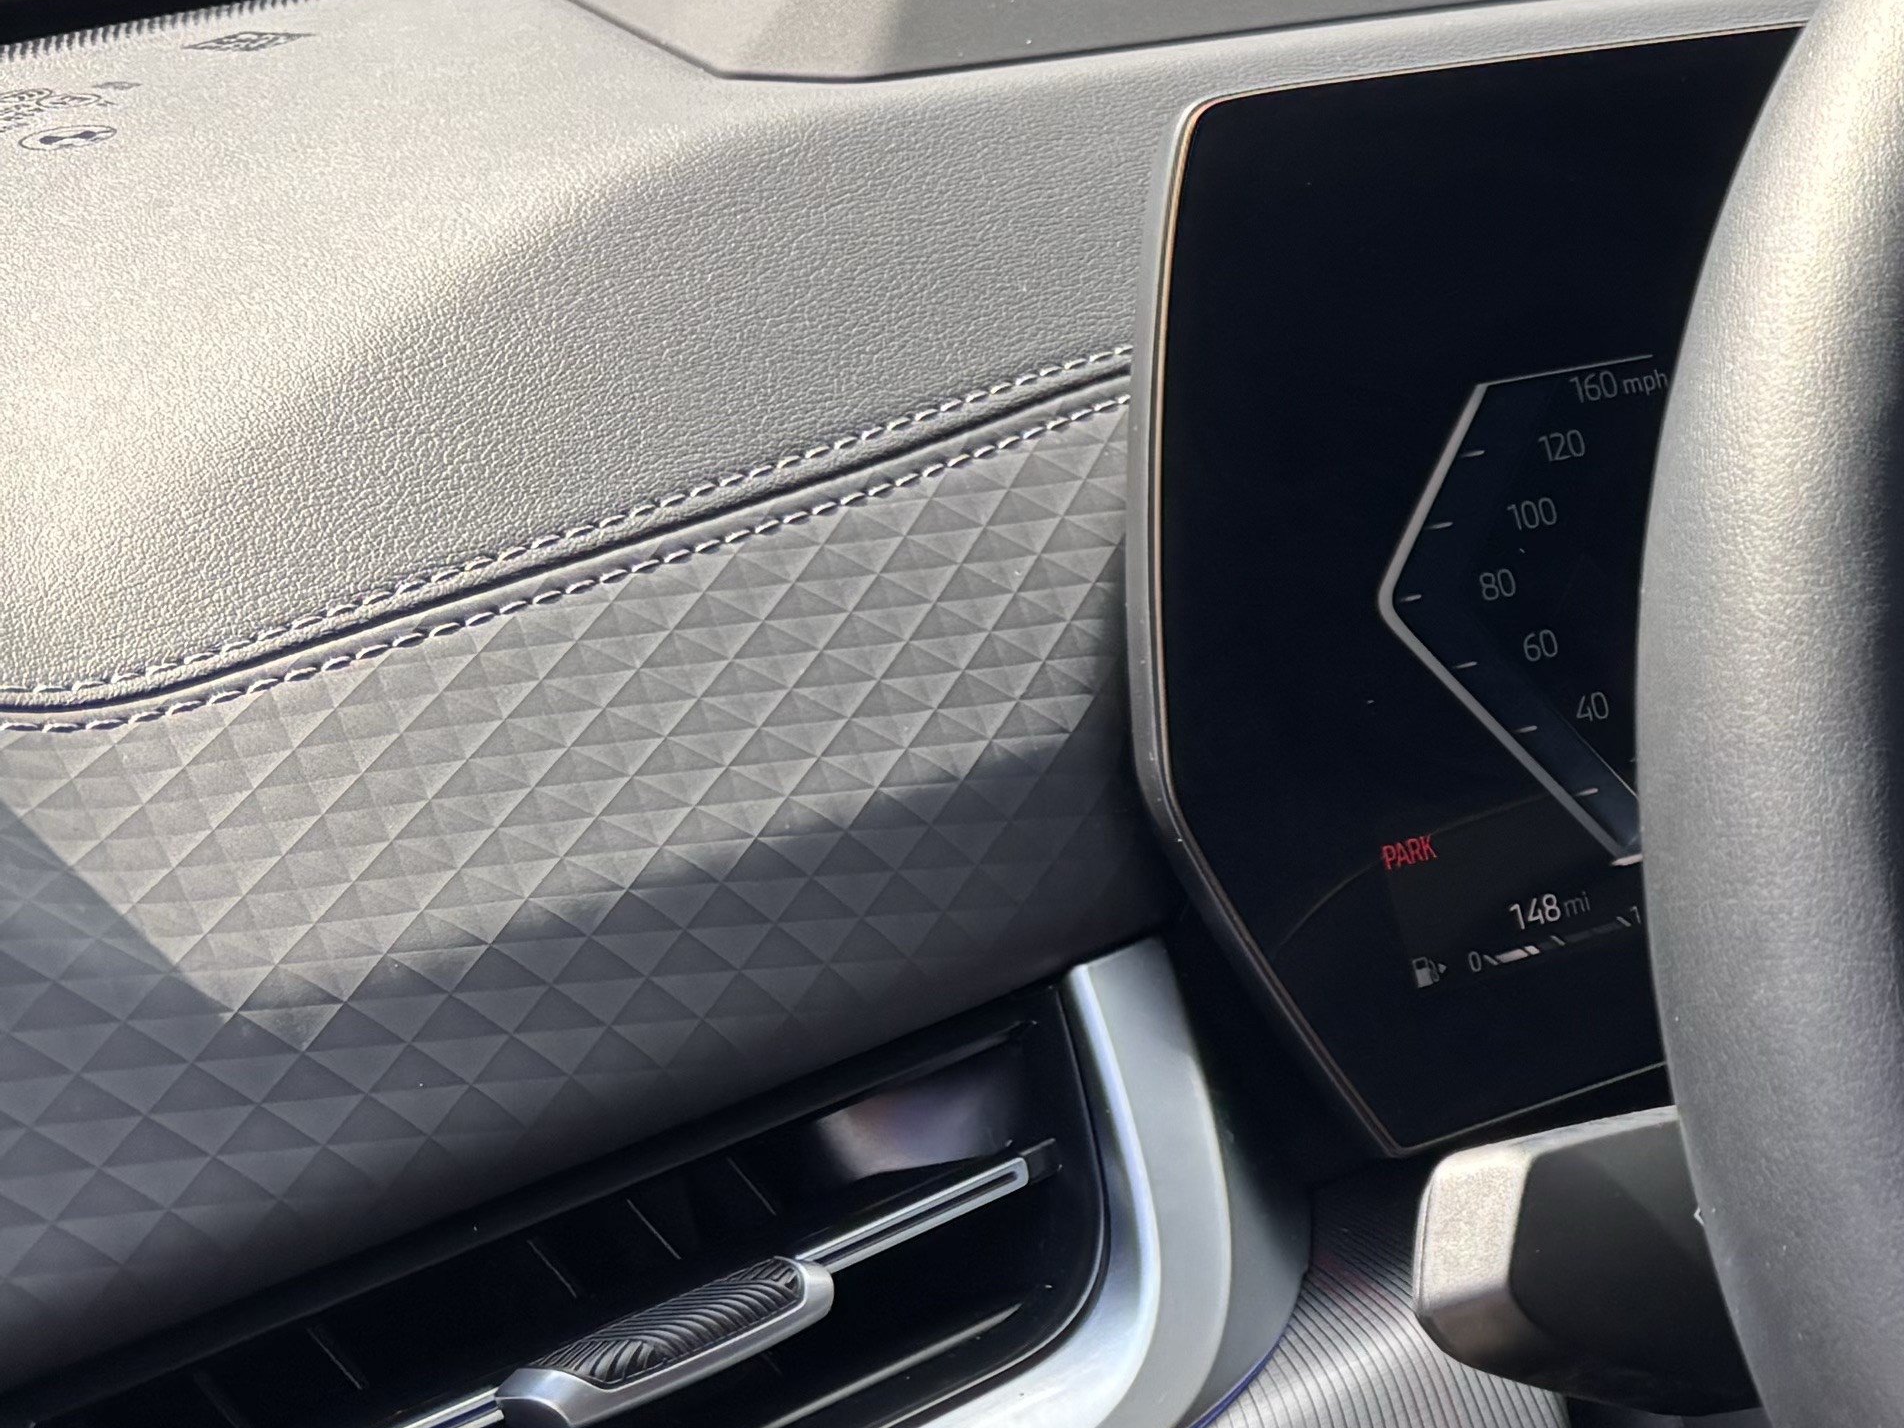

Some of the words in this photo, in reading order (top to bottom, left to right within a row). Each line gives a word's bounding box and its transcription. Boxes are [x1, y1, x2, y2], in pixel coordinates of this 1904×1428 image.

[1569, 370, 1618, 404] 160
[1622, 368, 1669, 396] mph
[1537, 428, 1586, 462] 120
[1506, 496, 1558, 531] 100
[1478, 568, 1517, 602] 80
[1522, 628, 1559, 663] 60
[1575, 691, 1610, 723] 40
[1381, 834, 1438, 871] PARK
[1508, 893, 1562, 930] 148
[1563, 890, 1591, 918] mi
